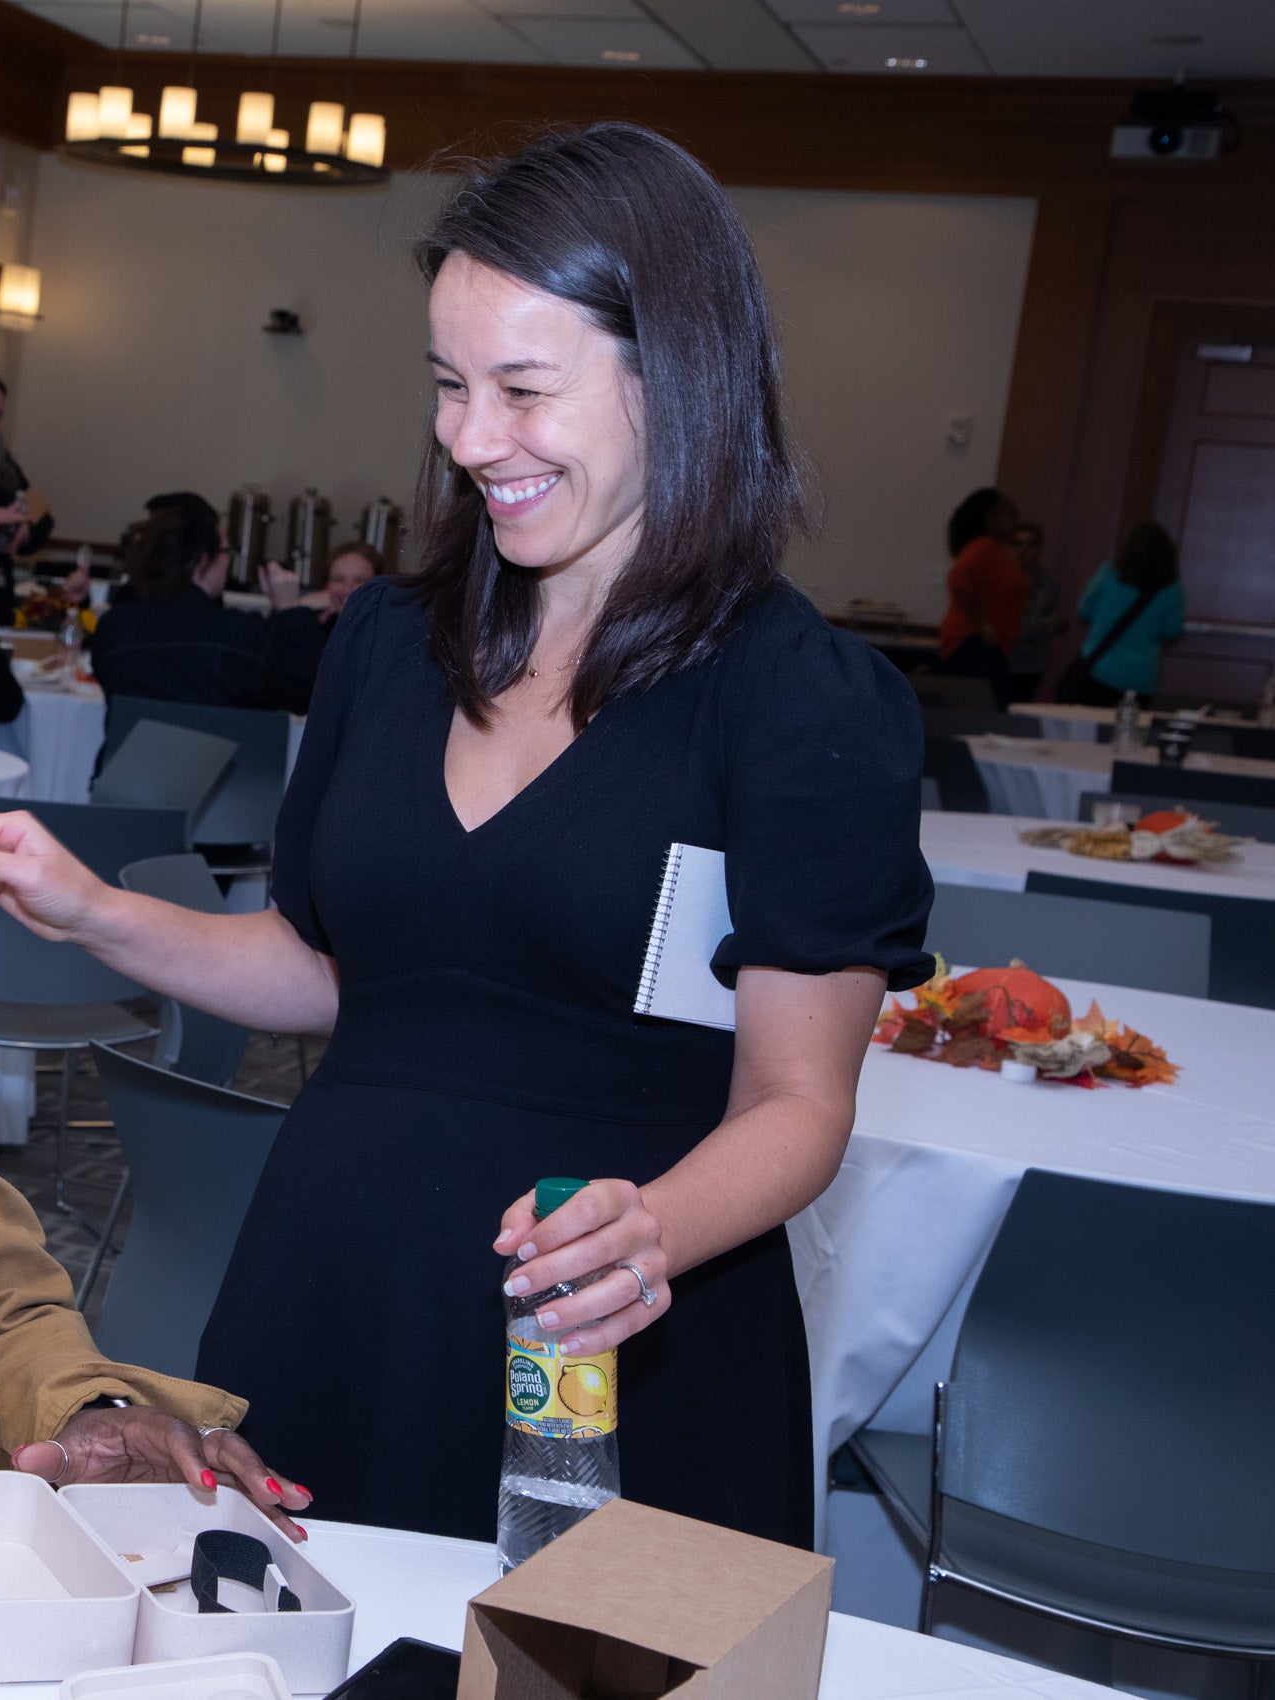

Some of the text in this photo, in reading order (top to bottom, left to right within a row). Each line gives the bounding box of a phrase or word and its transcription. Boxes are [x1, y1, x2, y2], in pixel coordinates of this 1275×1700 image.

[510, 1369, 542, 1384] Poland
[511, 1382, 544, 1397] Spring
[517, 1398, 539, 1407] LEMON
